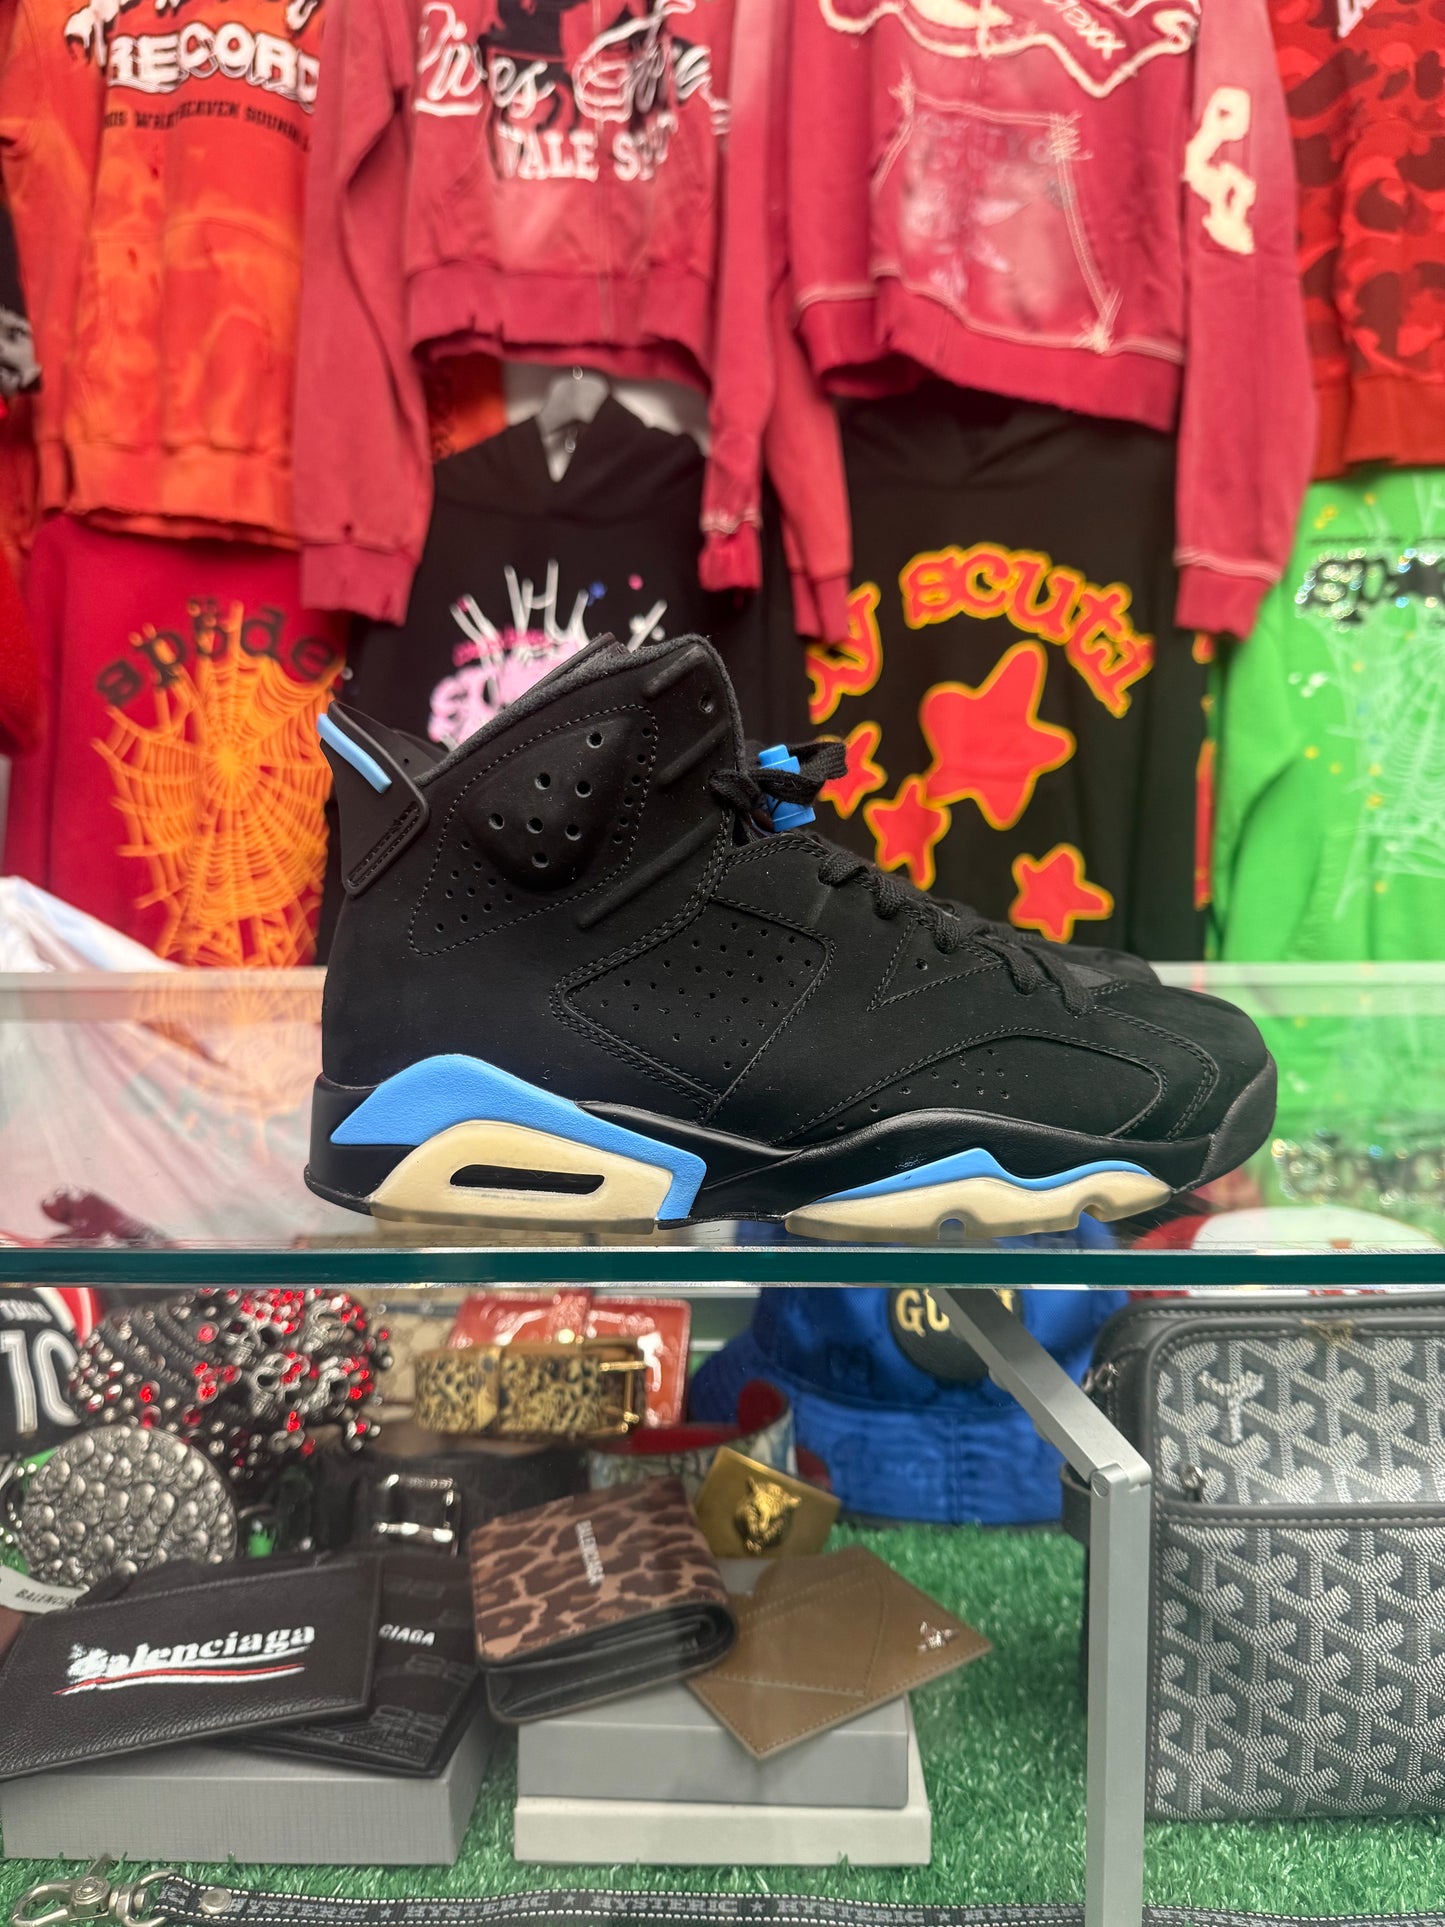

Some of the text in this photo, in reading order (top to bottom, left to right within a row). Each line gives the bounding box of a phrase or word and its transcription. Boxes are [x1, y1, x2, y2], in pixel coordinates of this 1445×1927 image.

[378, 1623, 436, 1647] CIAGA
[404, 1895, 550, 1919] HYSTERIC
[590, 1895, 738, 1913] HYSTERIC
[776, 1900, 925, 1924] HYSTERIC
